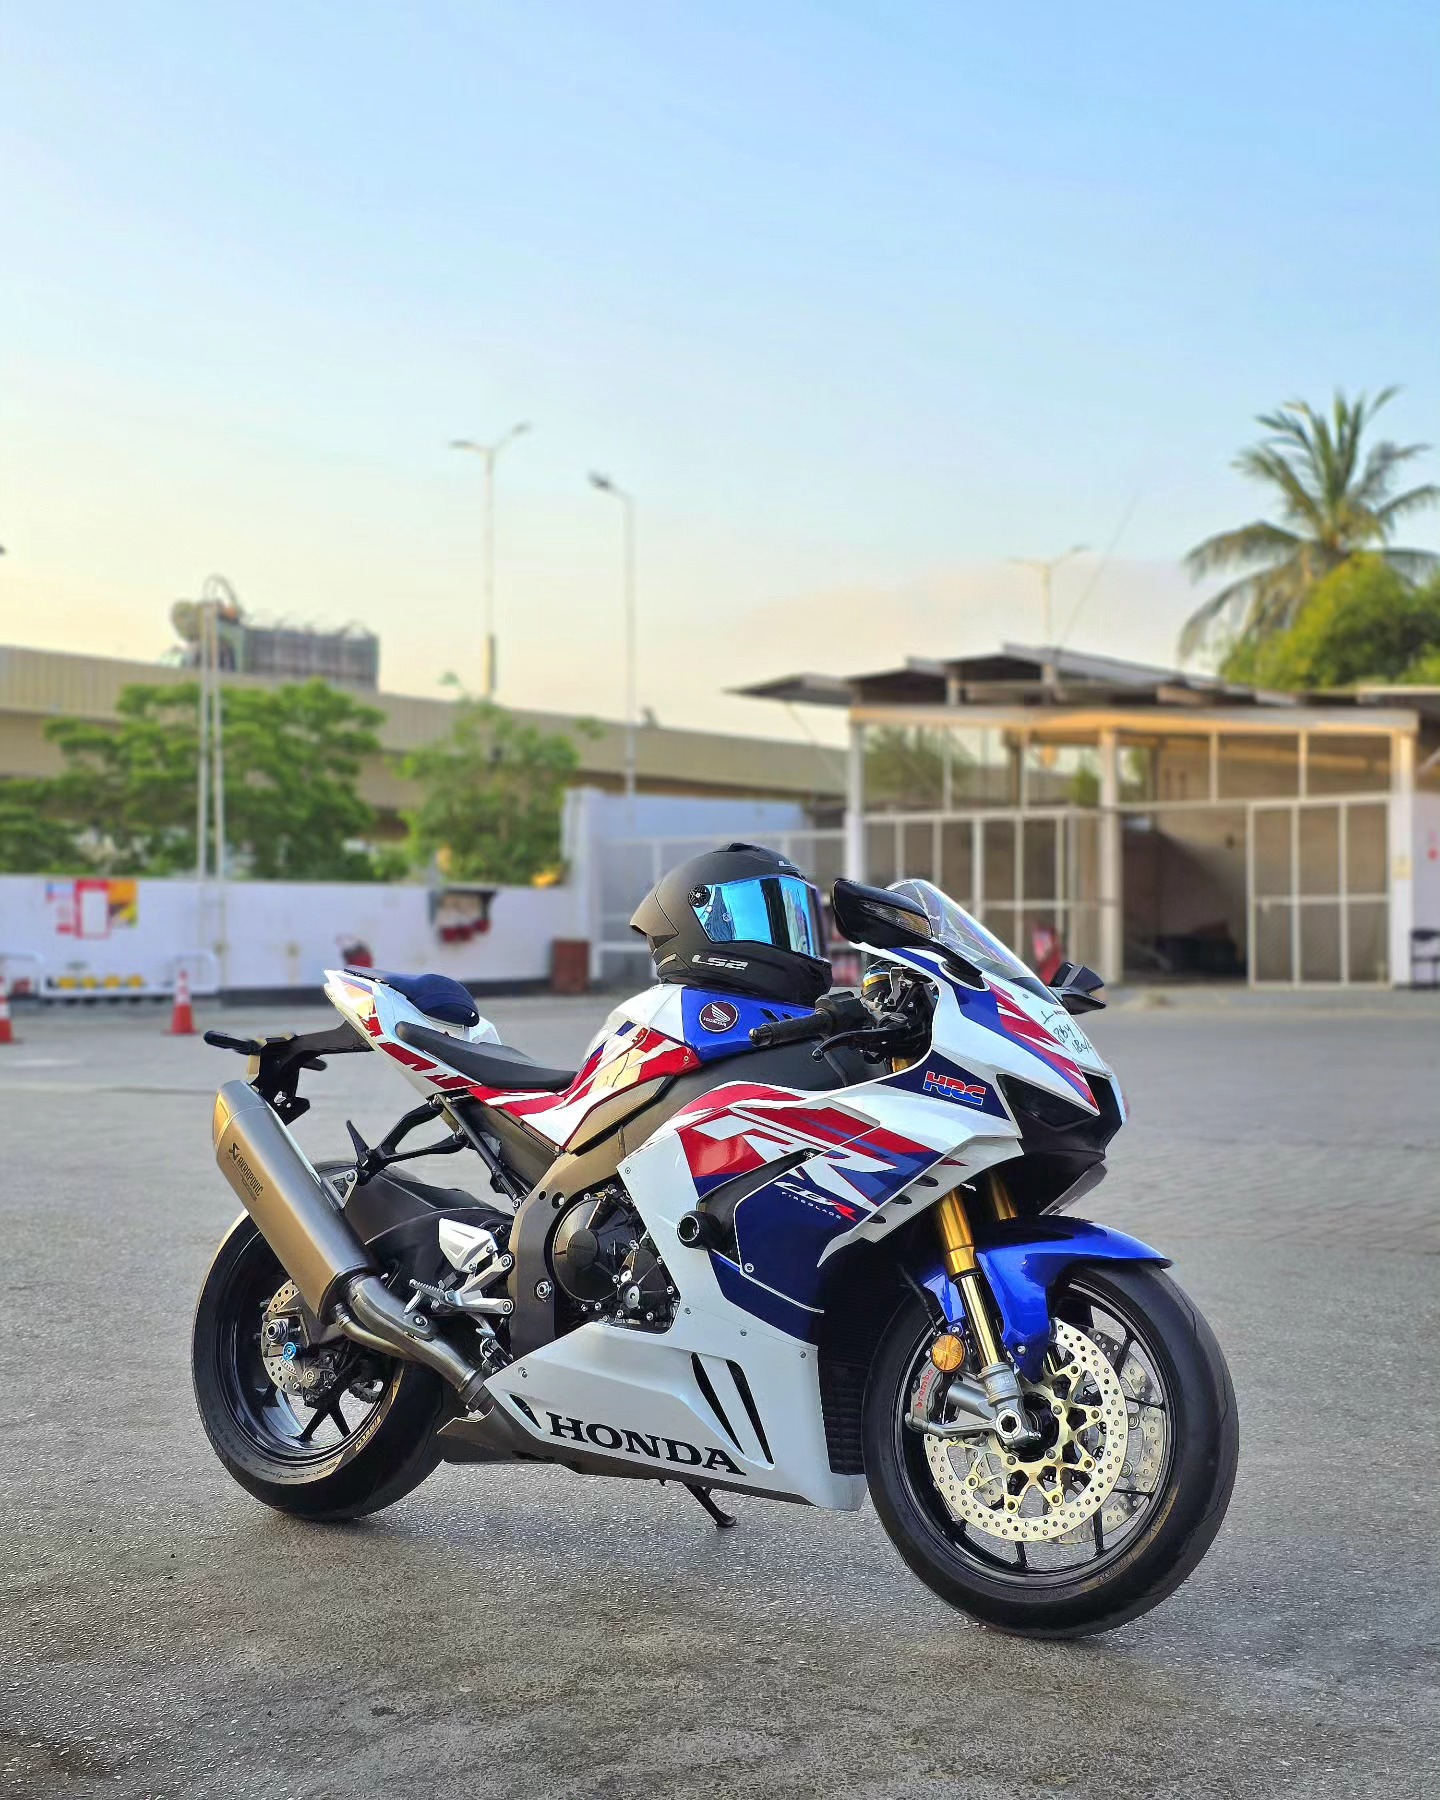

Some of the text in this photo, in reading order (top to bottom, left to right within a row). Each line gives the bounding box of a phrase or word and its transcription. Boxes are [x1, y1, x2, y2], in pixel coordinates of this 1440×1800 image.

[691, 954, 749, 970] LS2
[923, 1070, 986, 1105] HRC
[917, 1369, 934, 1409] brembo
[545, 1411, 747, 1476] HONDA
